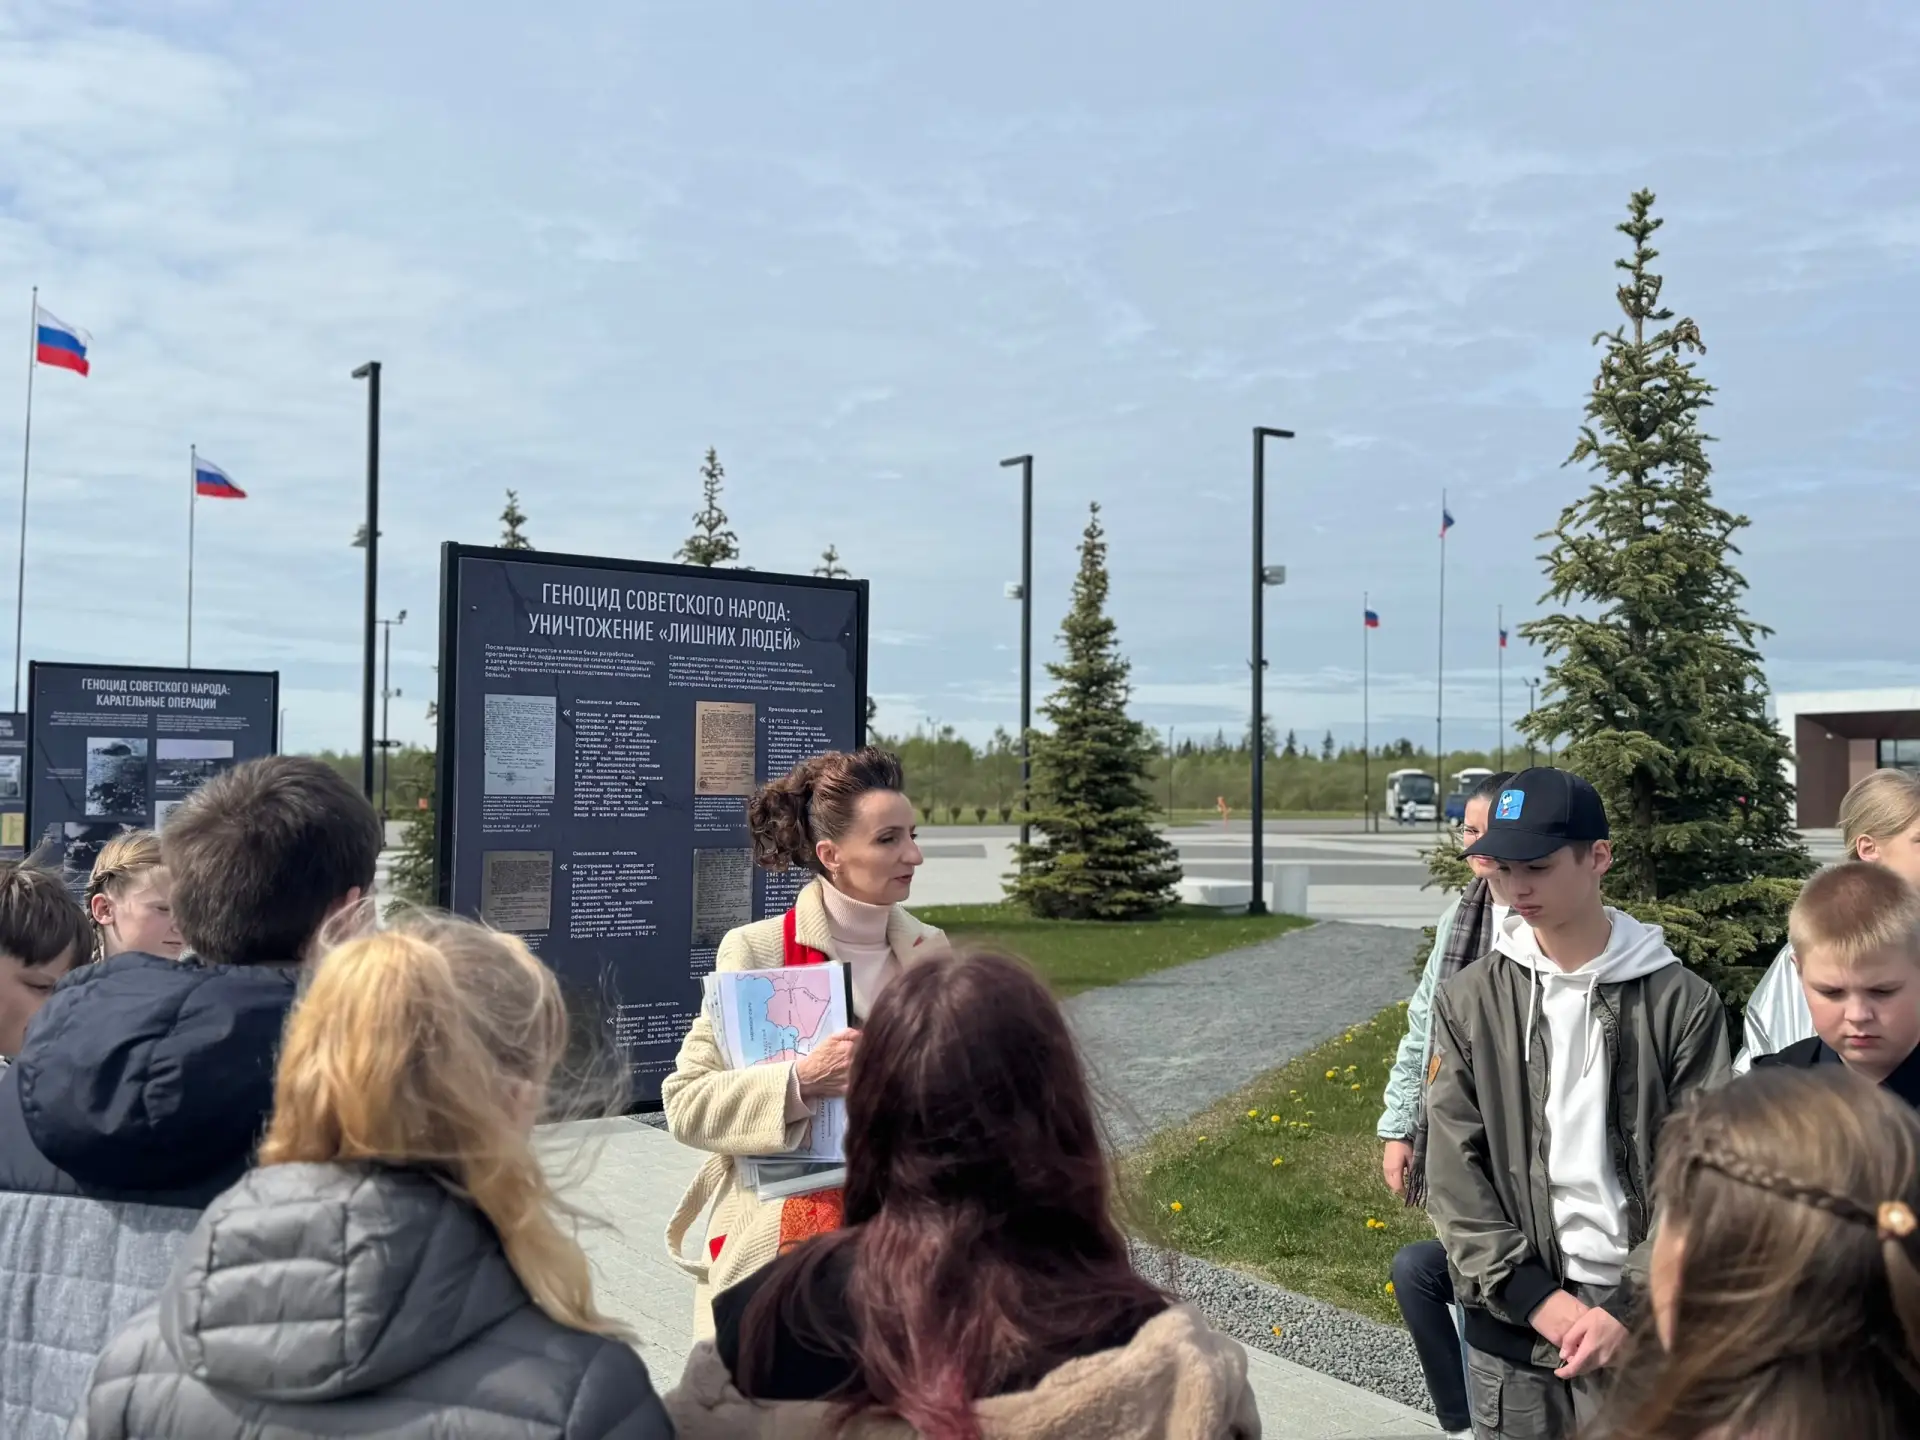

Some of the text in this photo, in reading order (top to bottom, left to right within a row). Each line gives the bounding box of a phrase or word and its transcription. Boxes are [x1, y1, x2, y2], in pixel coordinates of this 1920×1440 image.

[542, 583, 791, 623] ГЕНОЦИД СОВЕТСКОГО НАРОДА:
[529, 613, 801, 652] УНИЧТОЖЕНИЕ «ЛИШНИХ ЛЮДЕЙ»
[82, 678, 230, 695] ГЕНОЦИД СОВЕТСКОГО НАРОДА:
[97, 695, 216, 710] КАРАТЕЛЬНЫЕ ОПЕРАЦИИ
